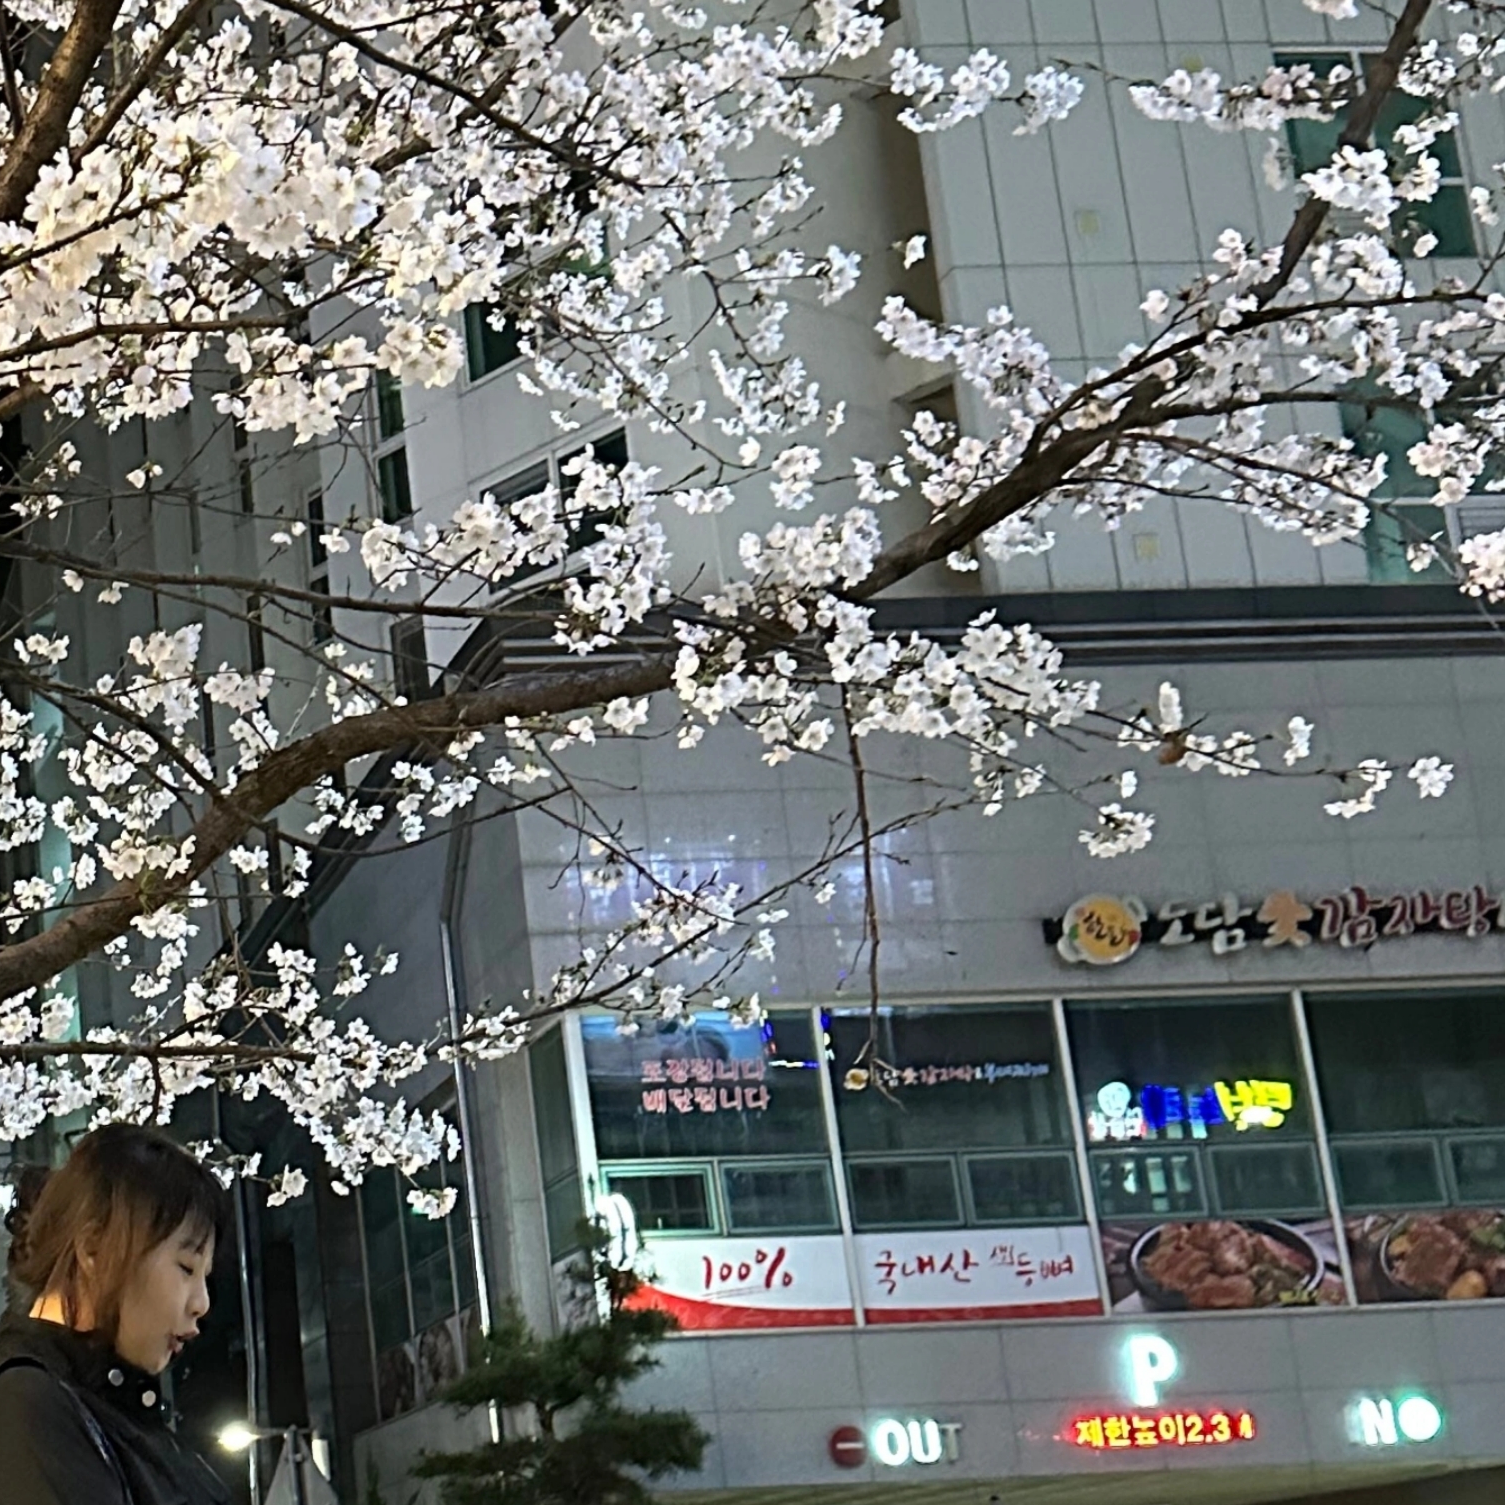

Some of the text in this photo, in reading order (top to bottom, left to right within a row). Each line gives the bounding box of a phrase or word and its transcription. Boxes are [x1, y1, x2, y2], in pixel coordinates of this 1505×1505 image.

[702, 1246, 793, 1290] 100%
[874, 1249, 979, 1295] 국내산
[1129, 1335, 1177, 1406] P
[874, 1418, 963, 1467] OUT
